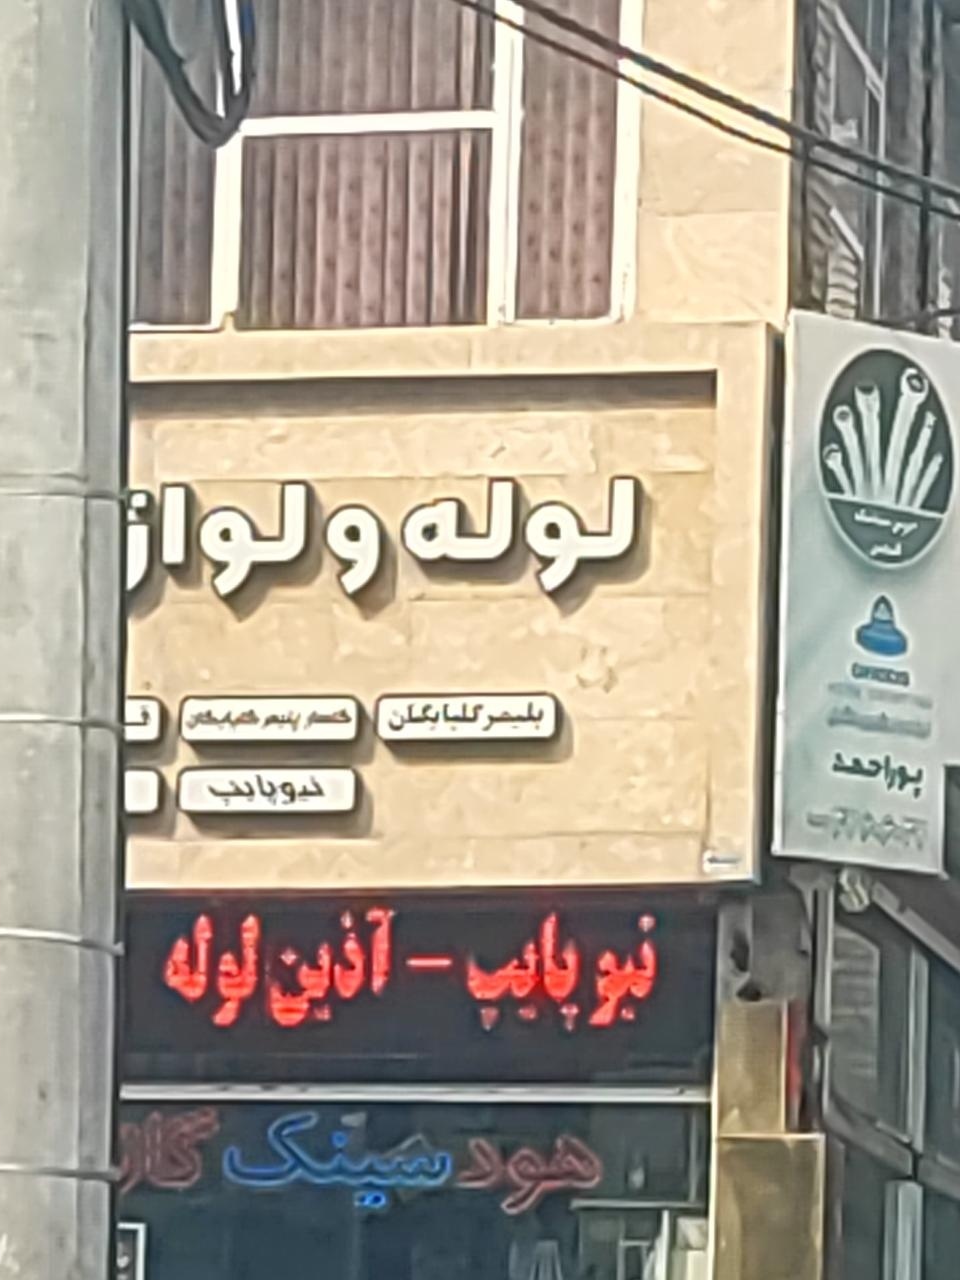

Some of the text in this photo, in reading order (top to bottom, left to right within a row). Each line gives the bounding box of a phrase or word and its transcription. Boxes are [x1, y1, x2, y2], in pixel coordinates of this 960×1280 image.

[324, 503, 381, 597] و
[401, 476, 637, 594] لوله
[164, 912, 261, 1027] لوله
[269, 906, 397, 1027] آذین
[223, 1110, 451, 1208] سینک
[454, 1133, 603, 1215] هود
